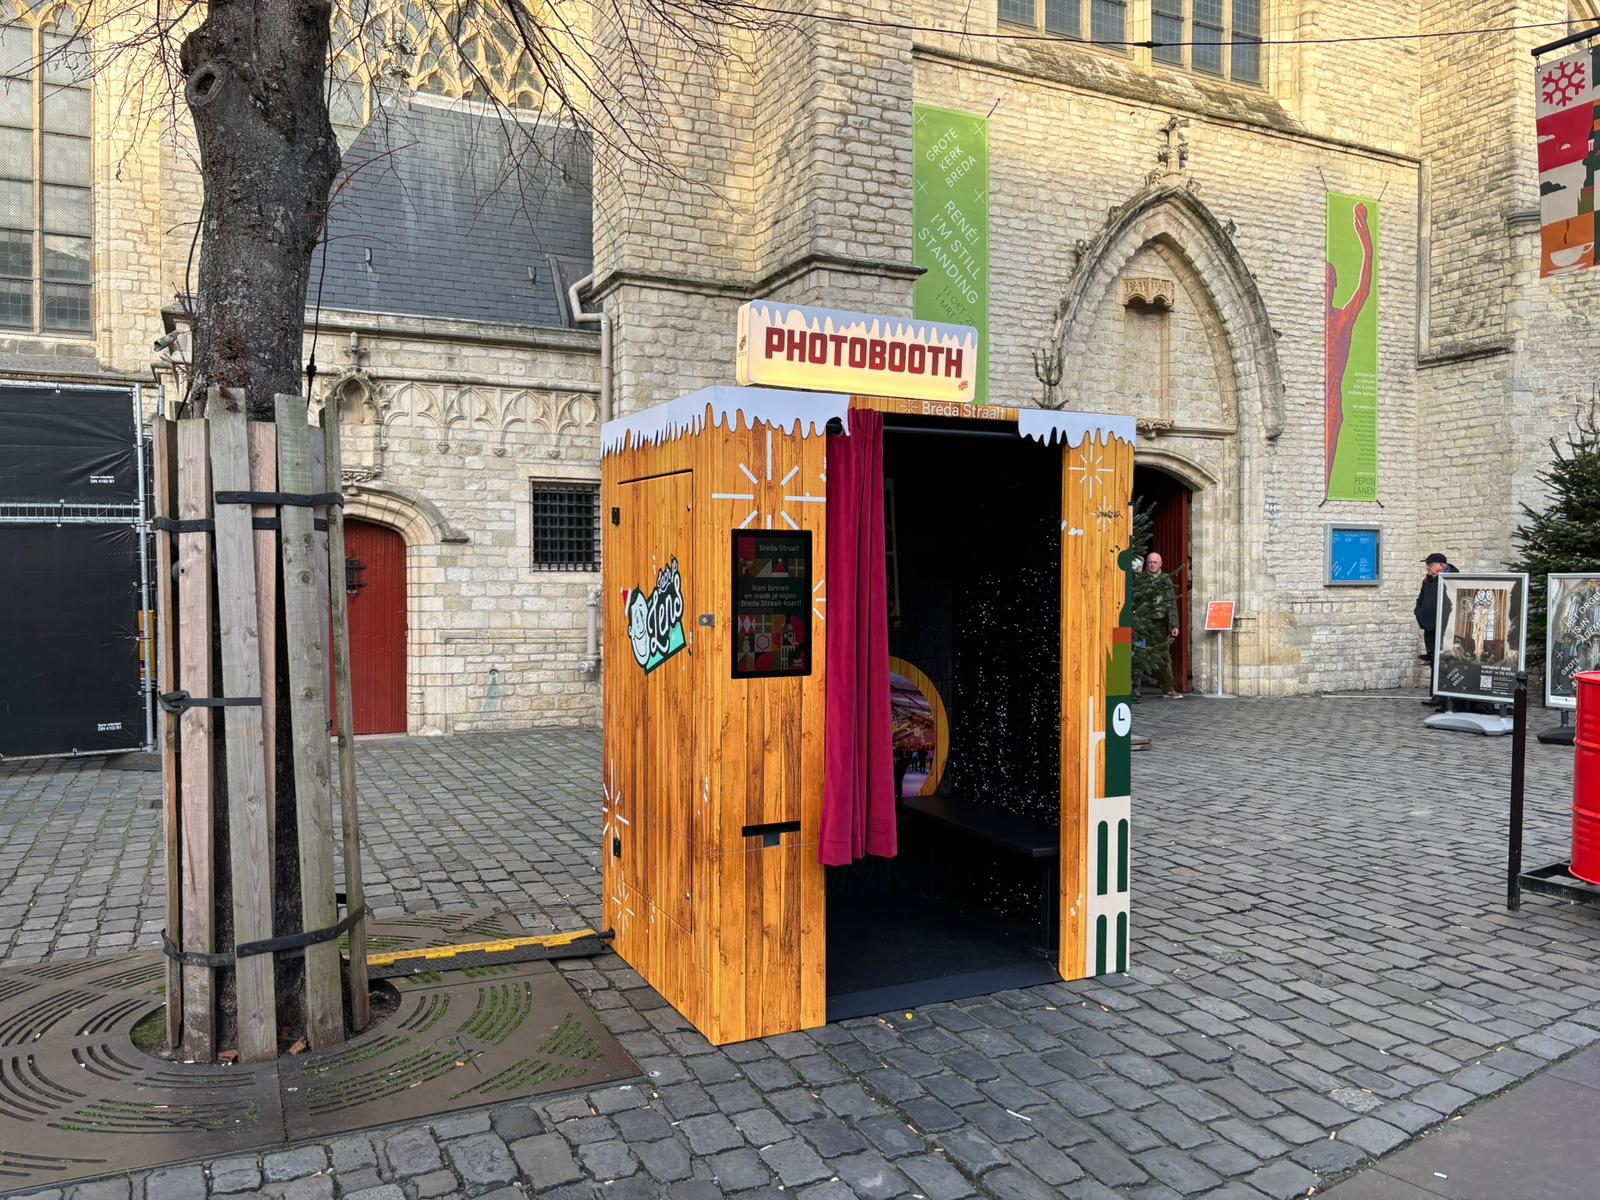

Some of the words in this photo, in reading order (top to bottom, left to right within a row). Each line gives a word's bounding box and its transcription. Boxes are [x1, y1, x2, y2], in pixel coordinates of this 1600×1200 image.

[926, 128, 958, 162] GROTE
[938, 144, 964, 172] KERK
[945, 155, 977, 188] BREDA
[930, 213, 953, 240] I'M
[950, 239, 981, 281] STILL
[918, 227, 979, 304] STANDING
[764, 326, 964, 379] PHOTOBOOTH
[922, 400, 960, 417] Breda
[962, 403, 1005, 420] Straalt
[759, 544, 779, 552] Breda
[740, 599, 760, 607] Breda
[1580, 617, 1591, 628] IN
[1561, 656, 1580, 676] GROTE
